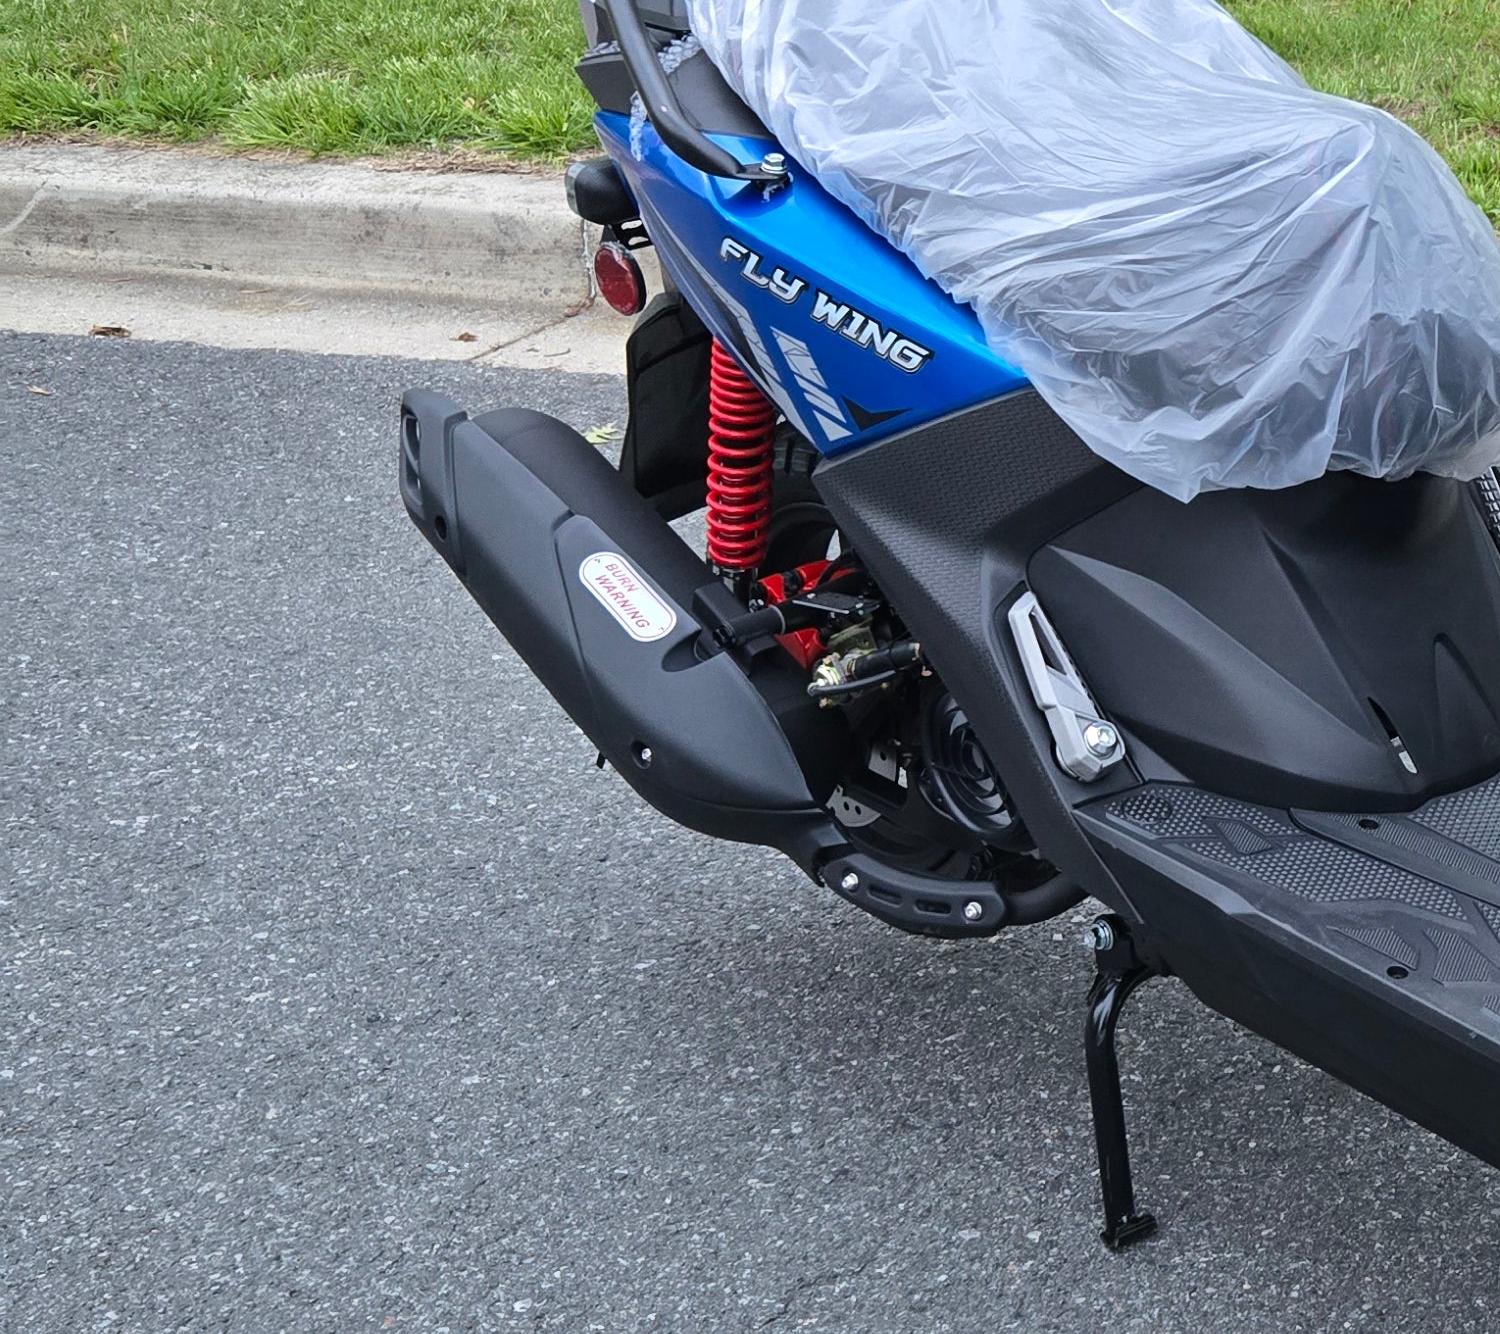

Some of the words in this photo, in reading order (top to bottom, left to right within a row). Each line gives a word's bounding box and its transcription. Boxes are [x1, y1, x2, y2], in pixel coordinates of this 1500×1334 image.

[719, 237, 808, 304] FLY
[810, 289, 933, 374] WING
[595, 574, 650, 628] WARNING
[605, 563, 639, 593] BURN
